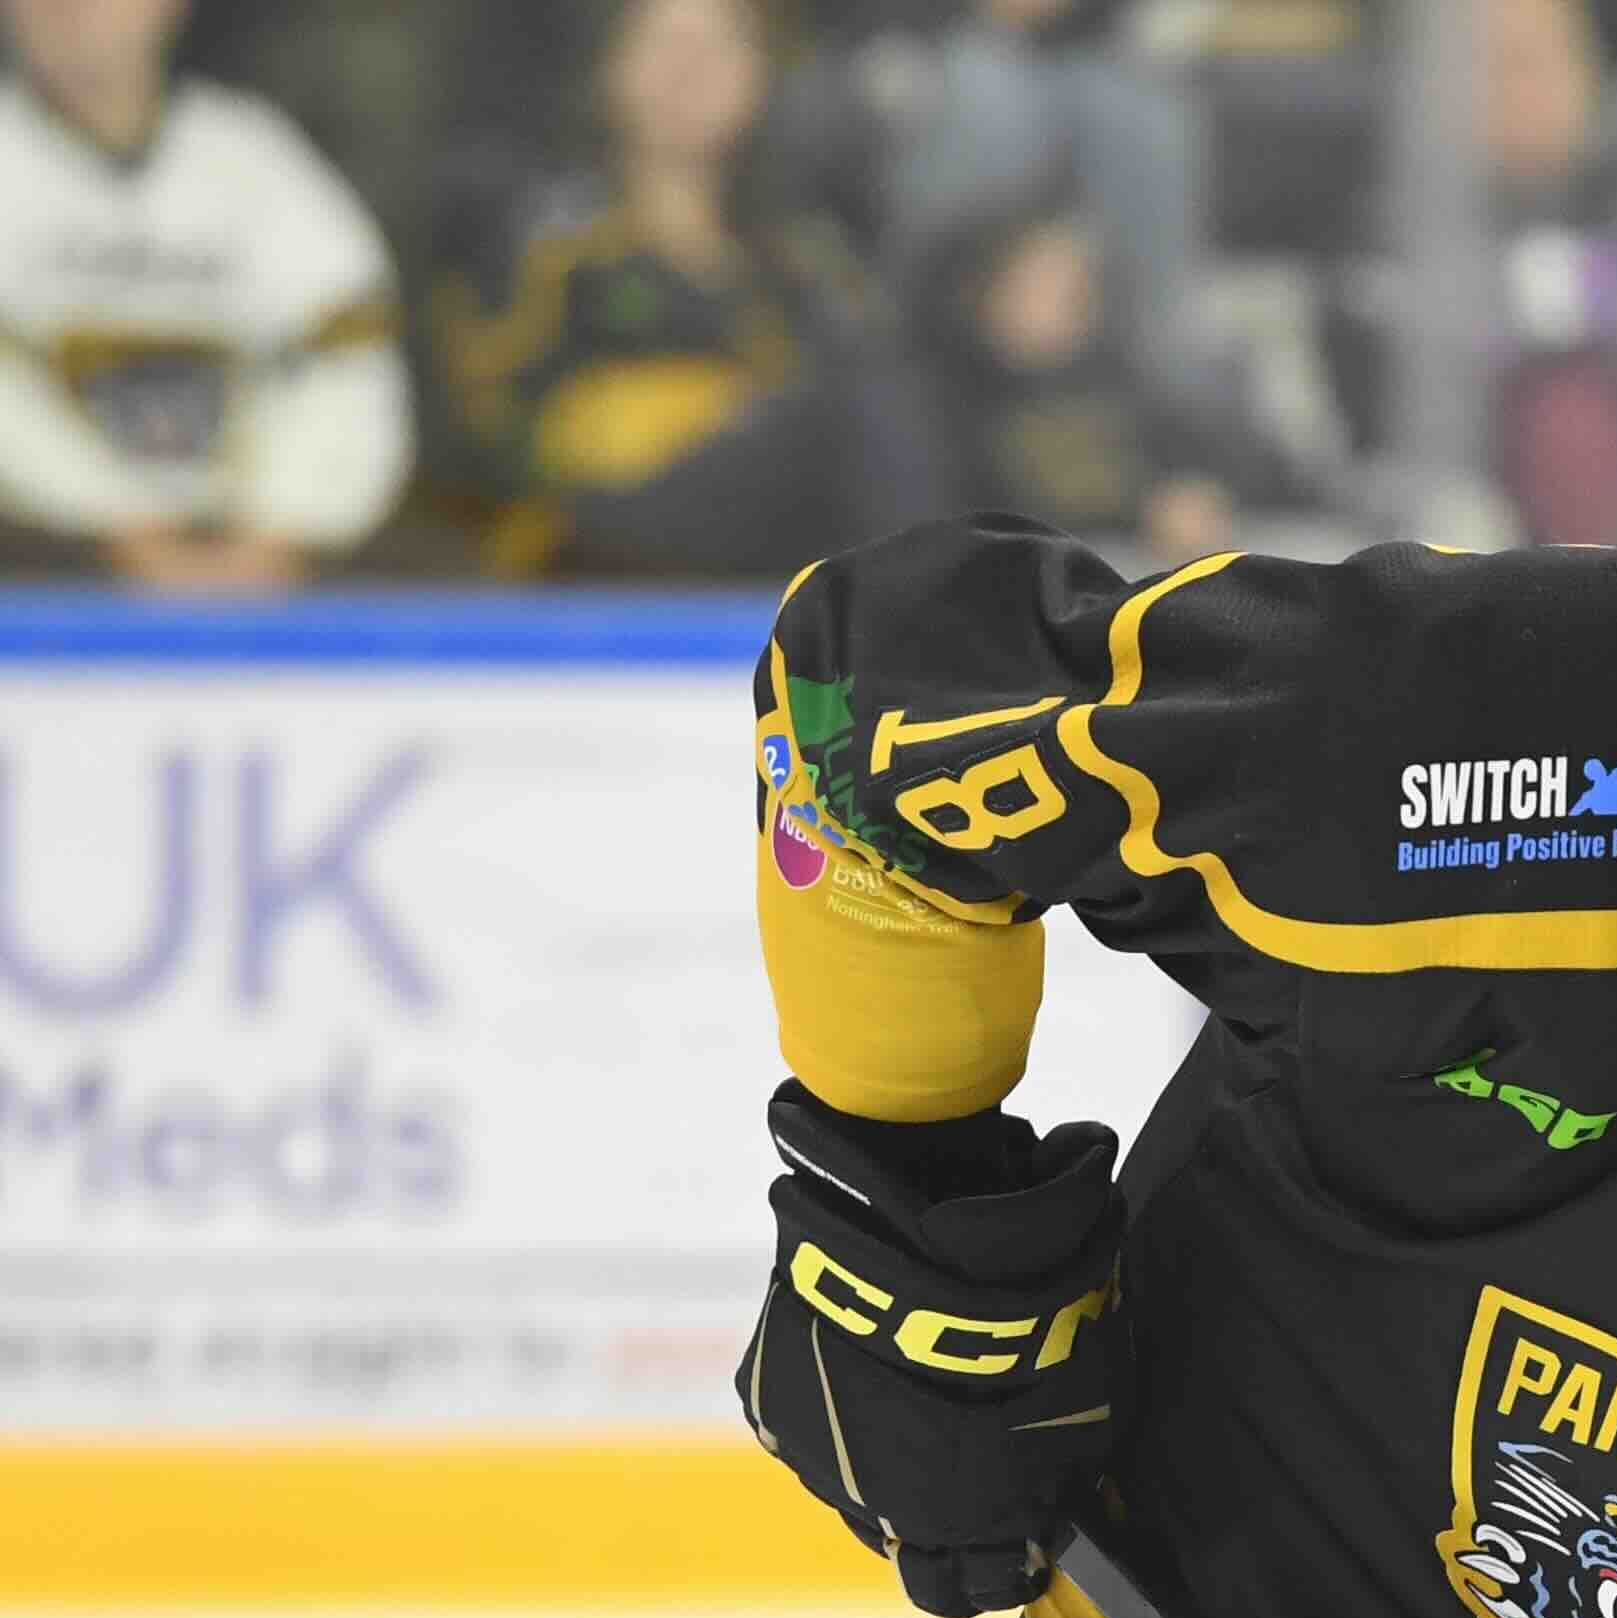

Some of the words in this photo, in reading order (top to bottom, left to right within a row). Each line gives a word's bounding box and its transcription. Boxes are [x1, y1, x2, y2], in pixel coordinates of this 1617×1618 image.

[1400, 756, 1569, 829] SWITCH
[1397, 837, 1500, 872] Building
[1506, 828, 1606, 863] Positive
